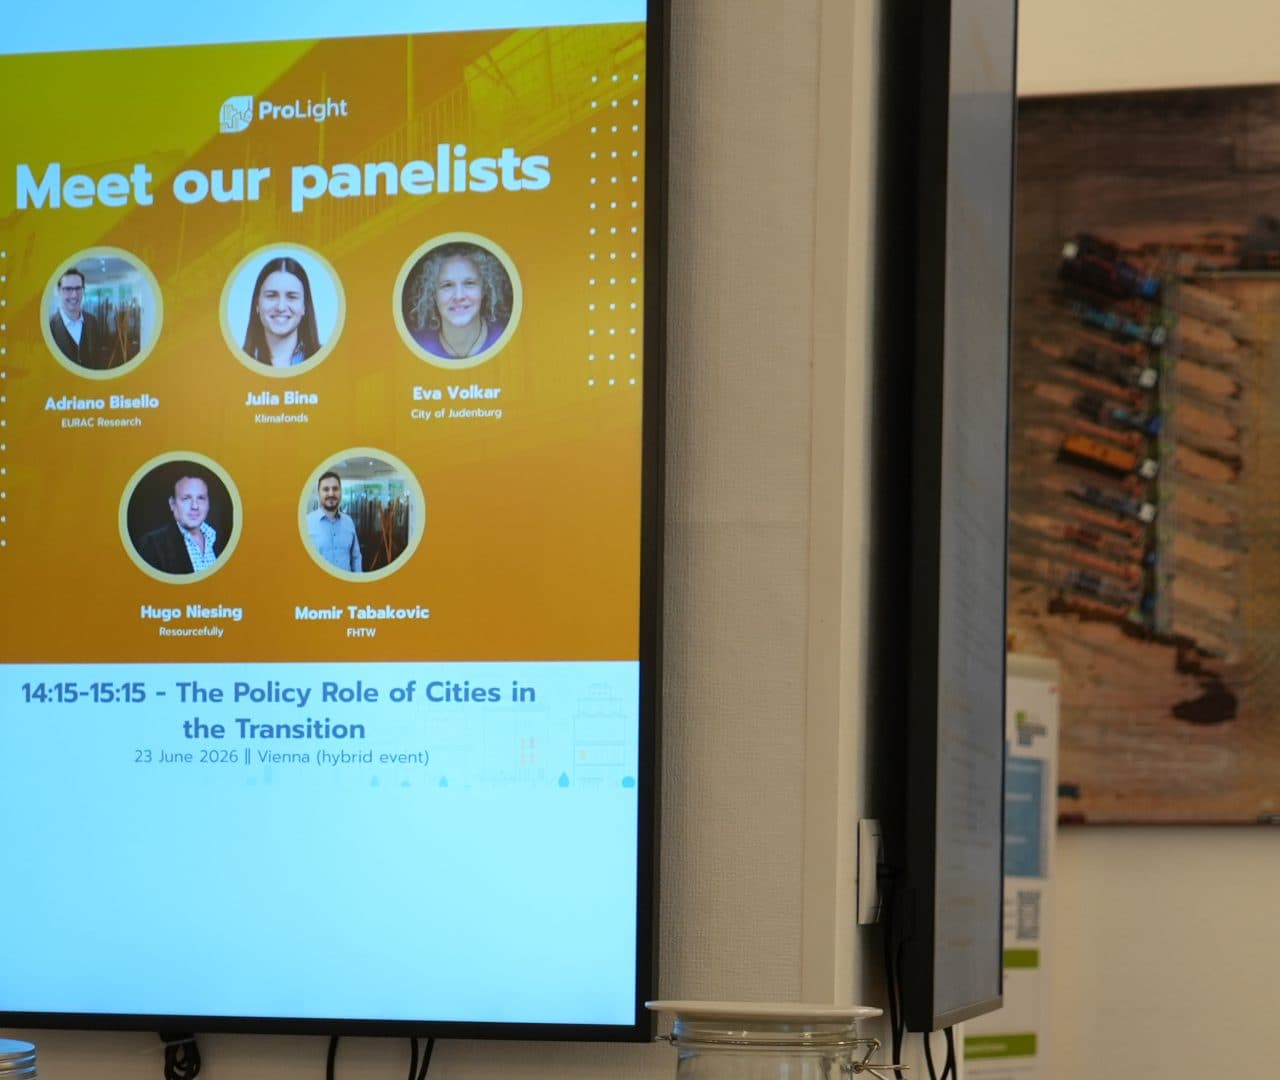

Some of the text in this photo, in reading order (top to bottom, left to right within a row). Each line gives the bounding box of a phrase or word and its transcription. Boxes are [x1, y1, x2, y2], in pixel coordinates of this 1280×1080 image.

[259, 98, 348, 122] ProLight
[16, 144, 552, 213] Meet our panelists
[245, 391, 319, 406] Julia Bina
[413, 385, 502, 401] Eva Volkar
[45, 394, 160, 411] Adriano Bisello
[254, 412, 309, 424] Klimafonds
[410, 407, 503, 420] City of Judenburg
[61, 416, 142, 428] EURAC Research
[140, 604, 244, 622] Hugo Niesing
[294, 605, 430, 621] Momir Tabakovic
[159, 626, 224, 639] Resourcefully
[346, 627, 377, 638] FHTW
[21, 682, 147, 704] 14:15-15:15
[176, 681, 224, 703] The
[233, 680, 312, 708] Policy
[322, 680, 379, 703] Role
[389, 680, 417, 703] of
[425, 680, 501, 703] Cities
[512, 680, 536, 702] in
[183, 717, 365, 740] the Transition
[134, 749, 153, 764] 23
[158, 749, 194, 764] June
[199, 749, 239, 764] 2026
[257, 749, 310, 764] Vienna
[316, 749, 373, 767] (hybrid
[379, 750, 430, 767] event)
